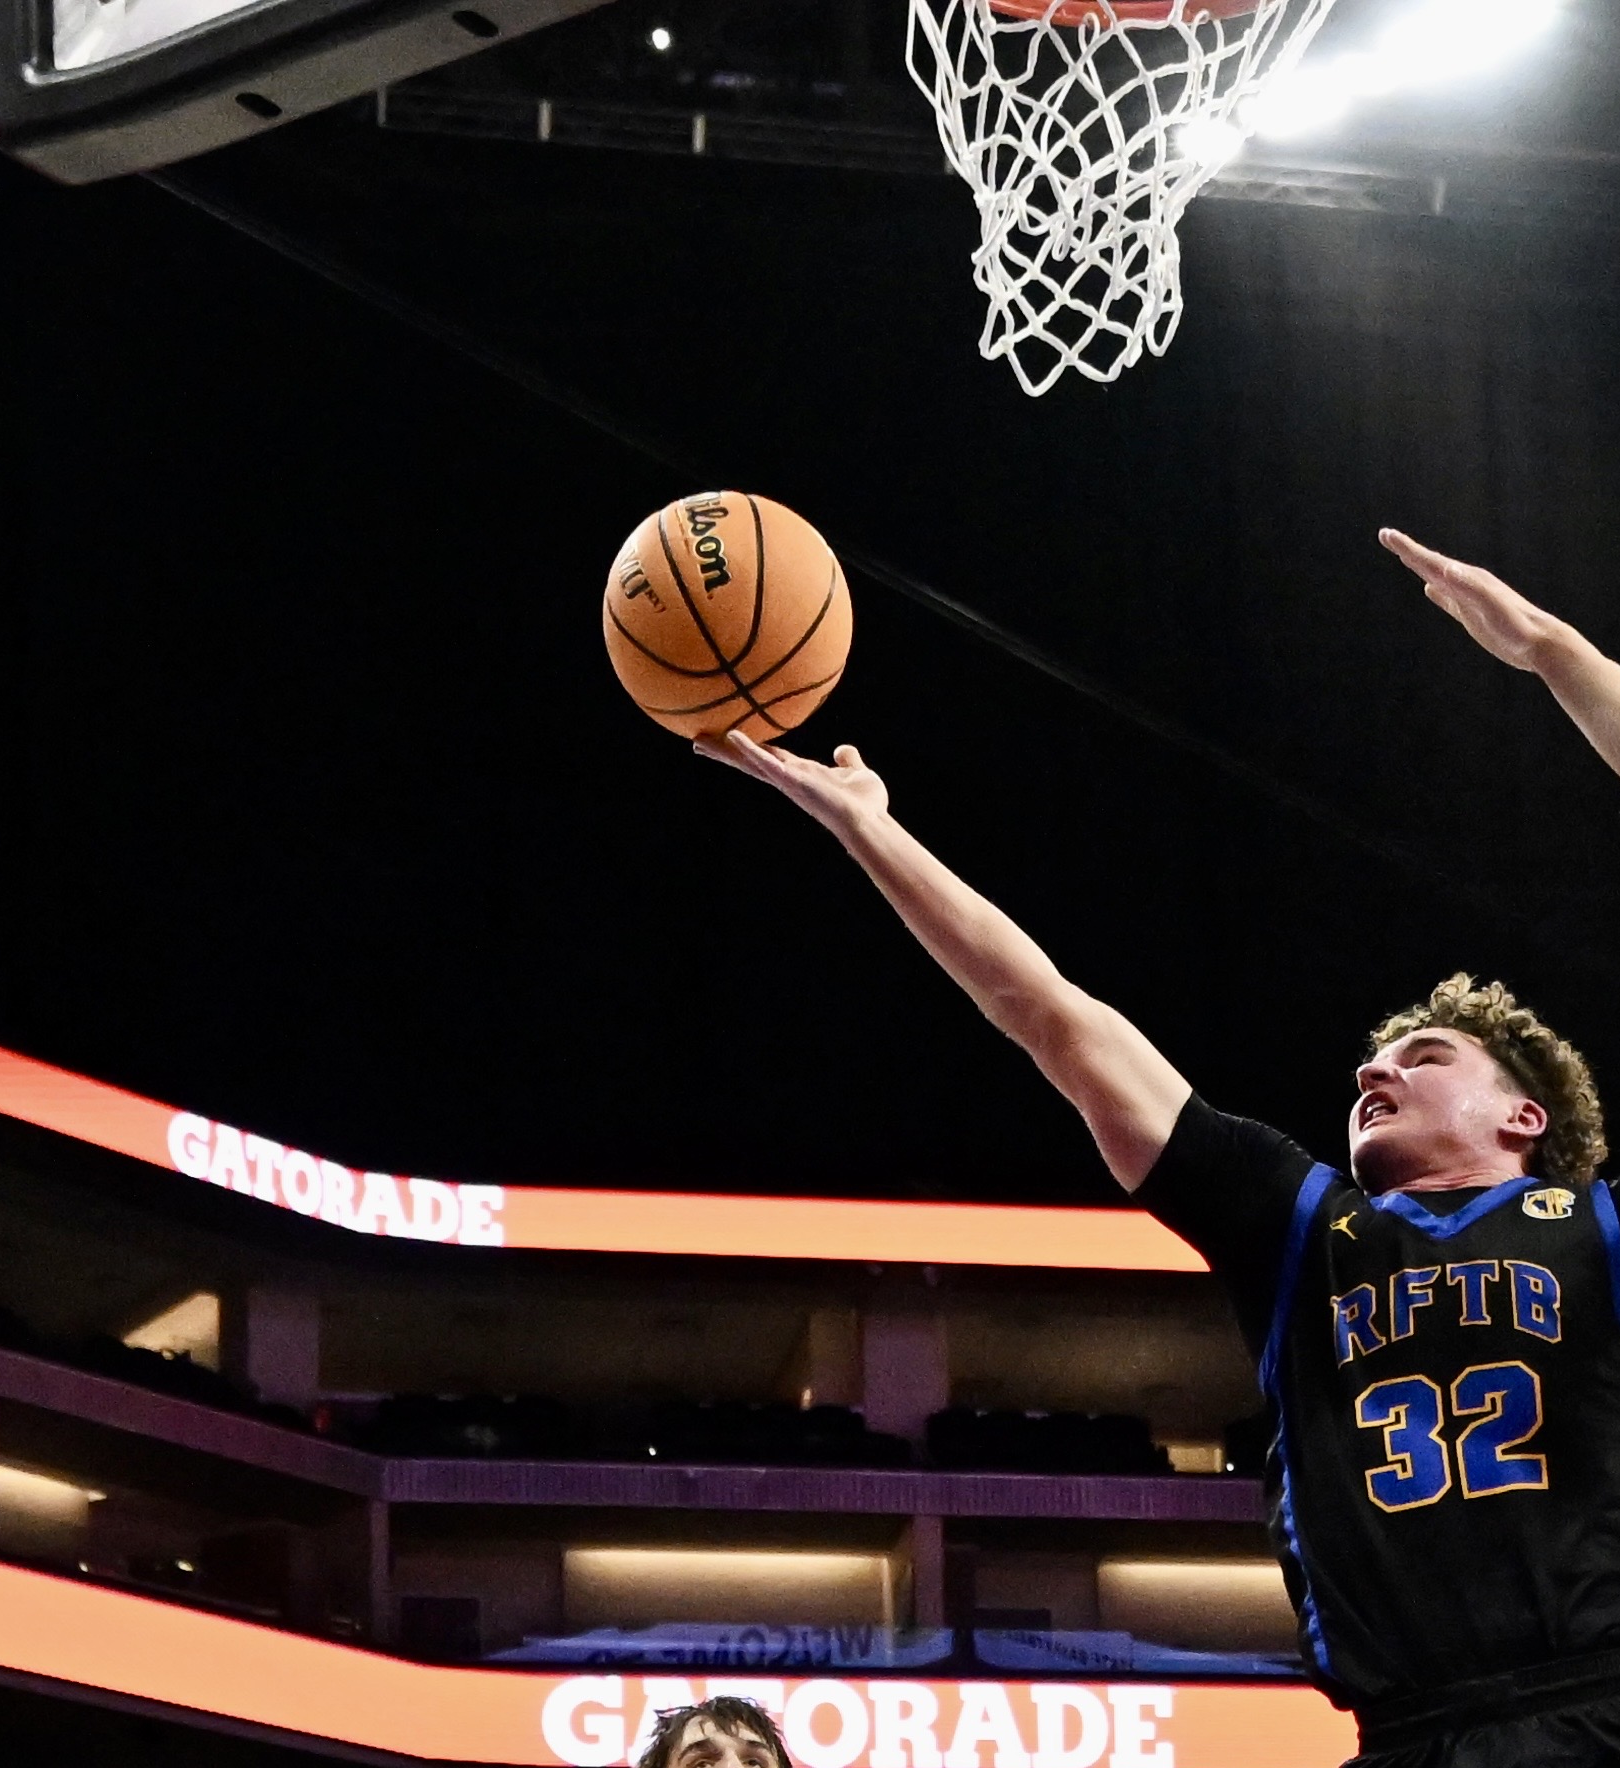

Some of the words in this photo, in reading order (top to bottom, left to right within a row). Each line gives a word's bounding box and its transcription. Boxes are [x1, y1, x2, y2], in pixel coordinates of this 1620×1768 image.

[683, 493, 732, 594] ilson
[167, 1110, 505, 1247] GATORADE
[1330, 1259, 1563, 1370] RFTB
[1354, 1359, 1550, 1514] 32
